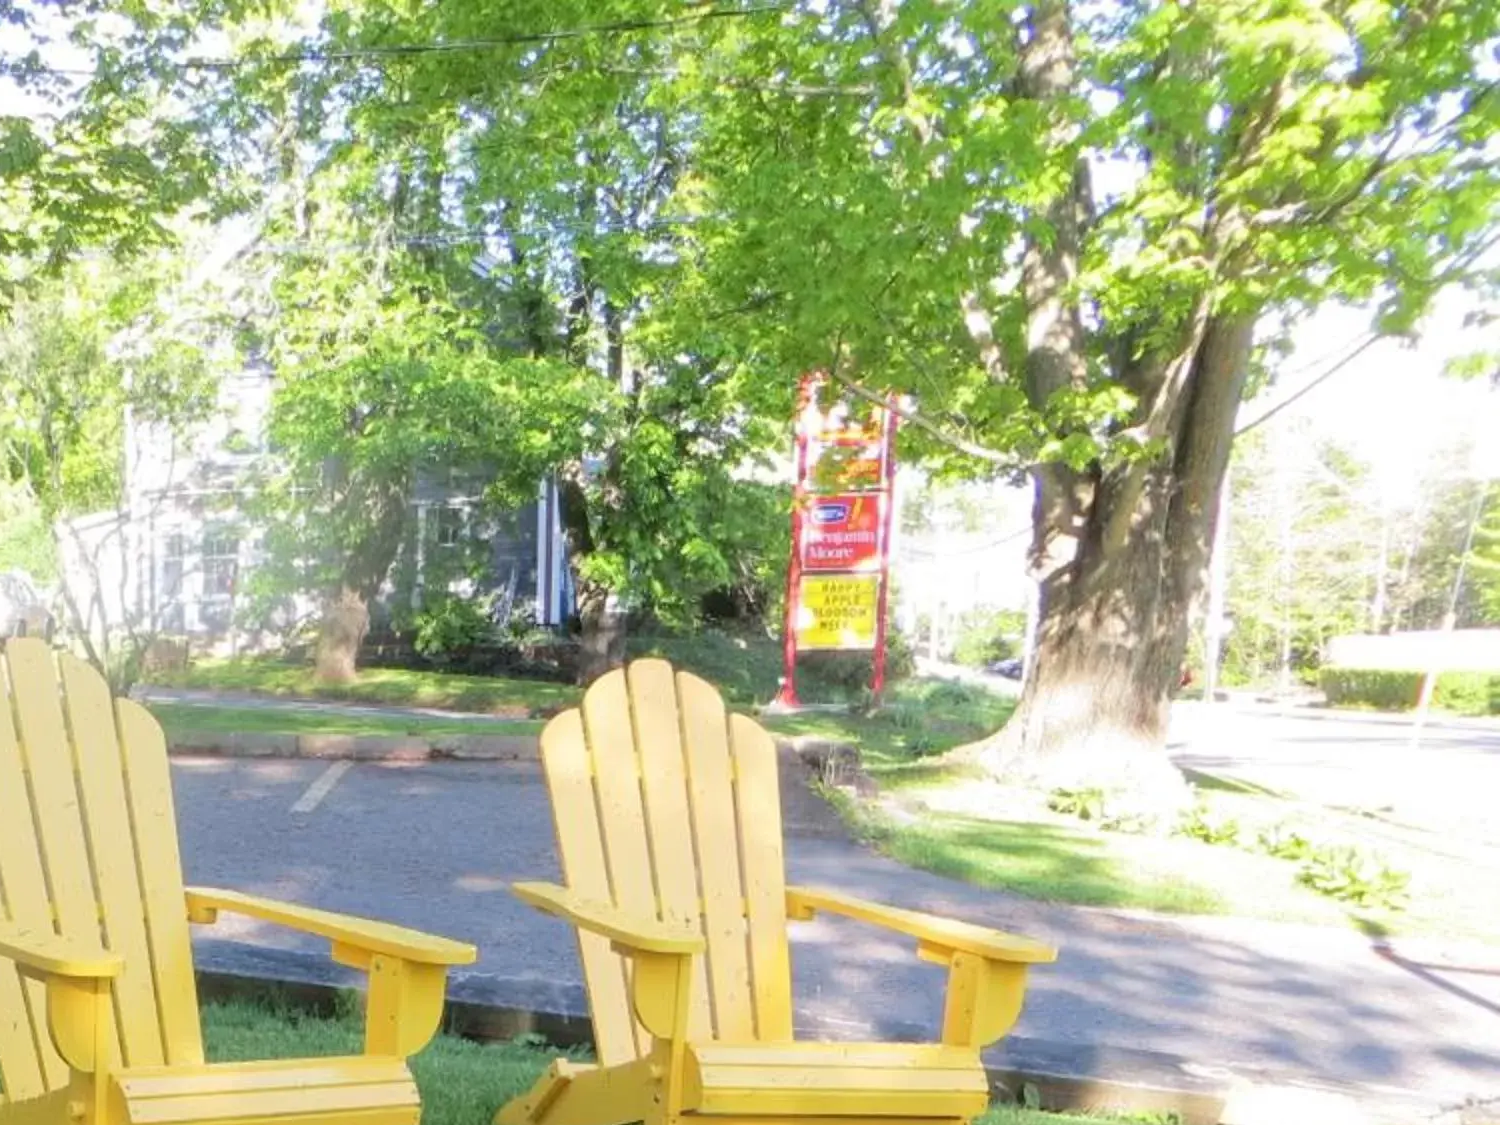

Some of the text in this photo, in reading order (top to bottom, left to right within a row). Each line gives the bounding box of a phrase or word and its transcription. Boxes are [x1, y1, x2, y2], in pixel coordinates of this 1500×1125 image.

[806, 530, 875, 546] enjamin
[808, 546, 854, 560] Moore
[821, 583, 861, 593] HAPPY
[823, 594, 860, 606] APPLE
